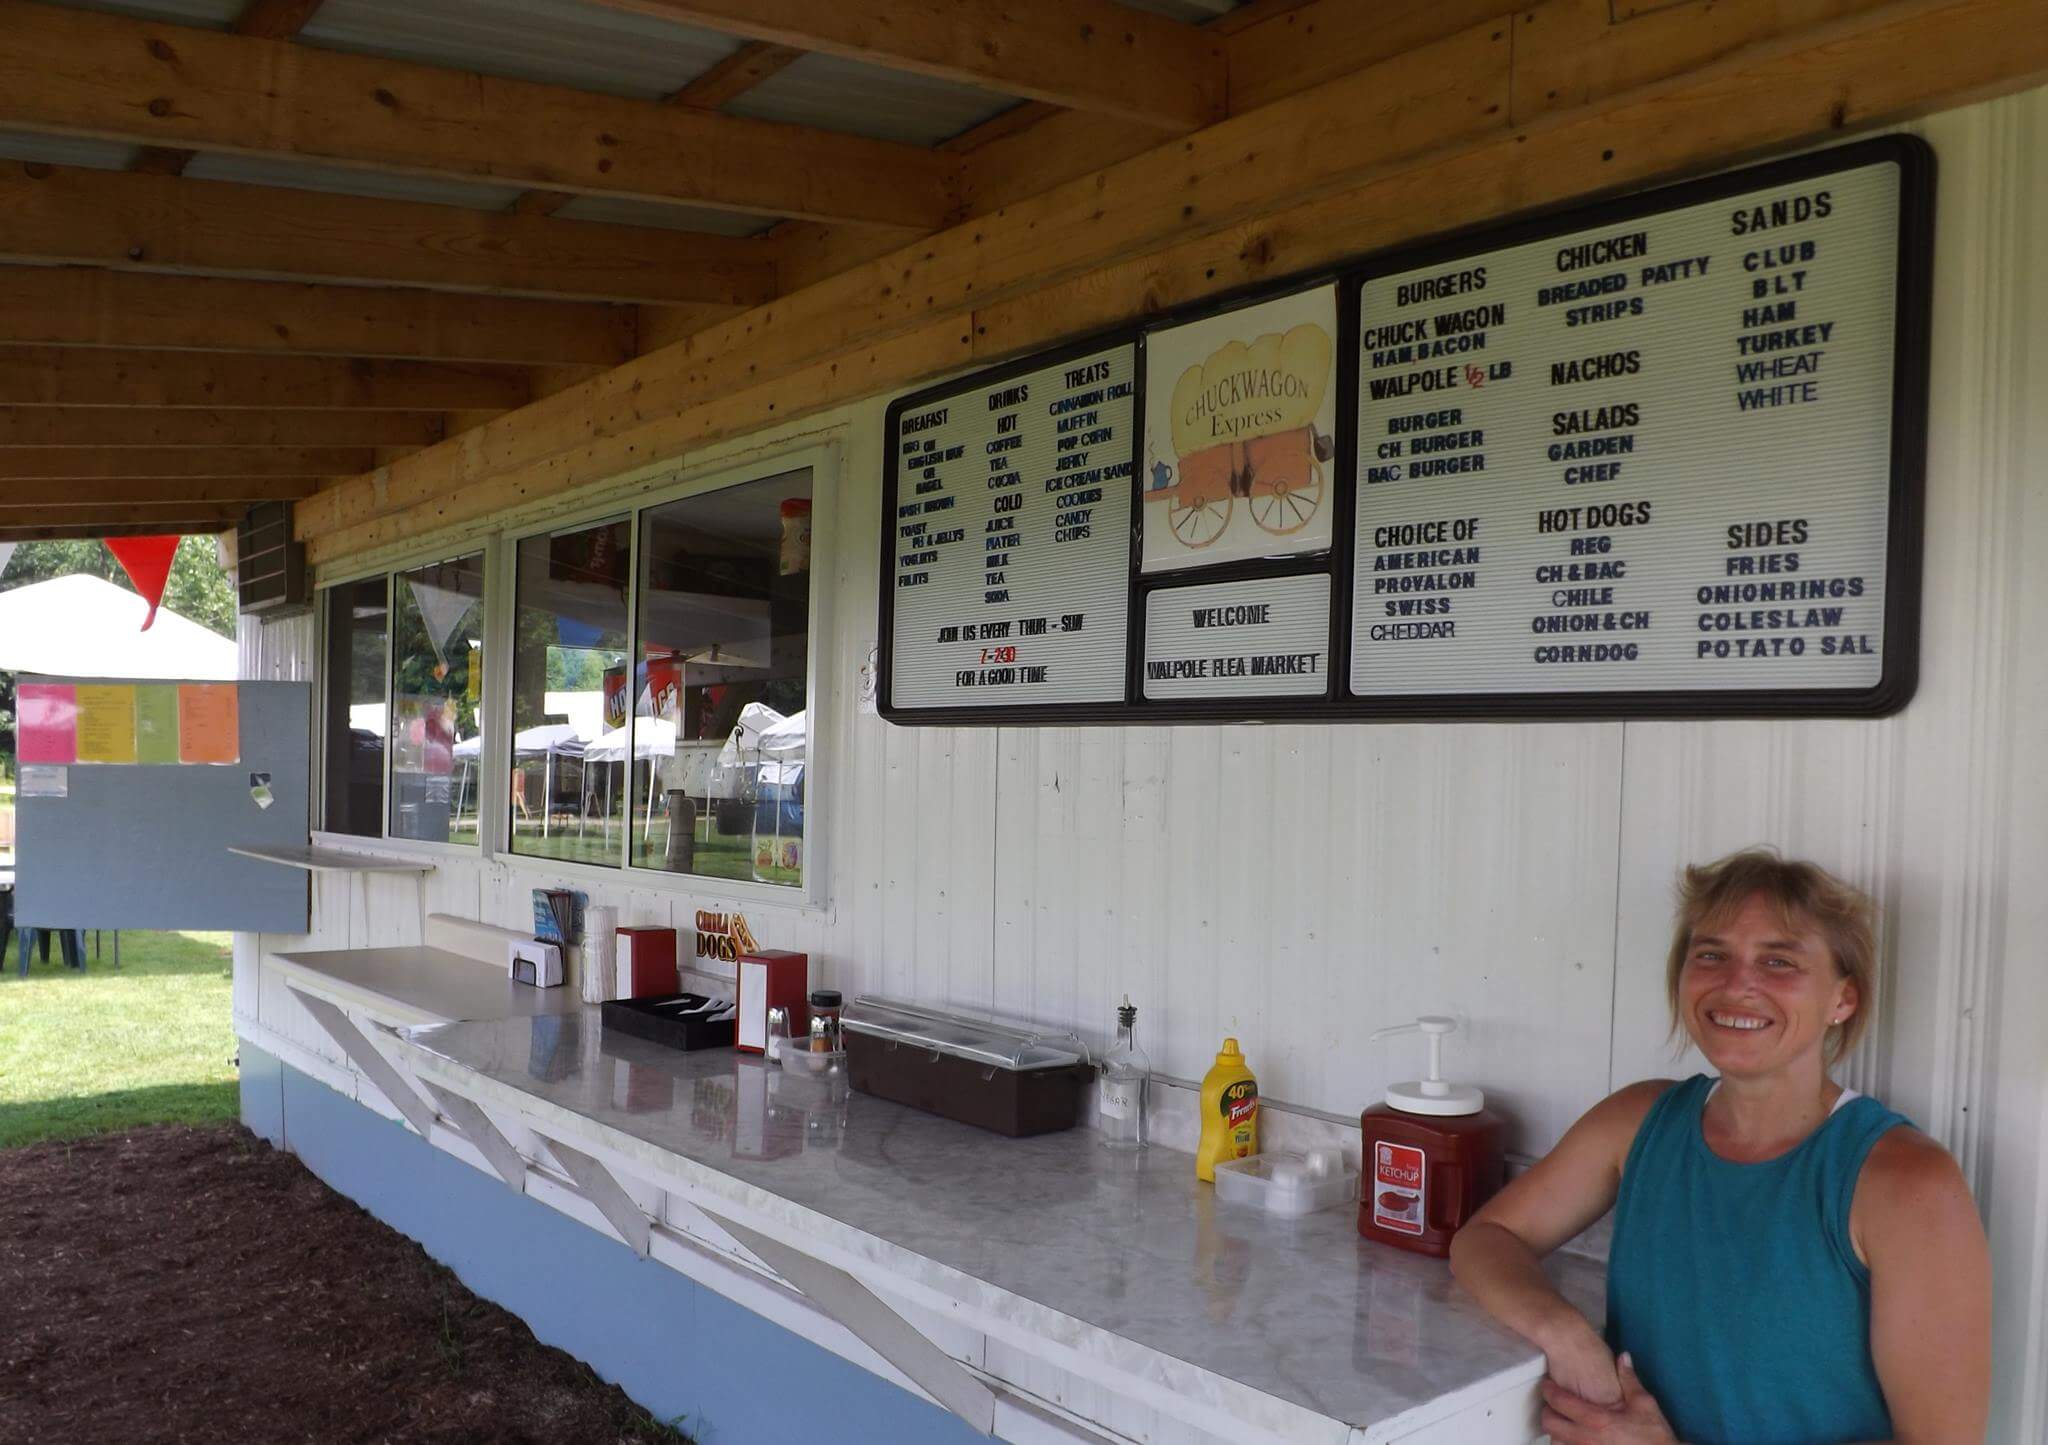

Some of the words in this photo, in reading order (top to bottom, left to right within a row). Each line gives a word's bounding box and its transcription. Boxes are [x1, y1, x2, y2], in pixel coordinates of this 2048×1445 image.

[1731, 191, 1832, 236] SANDS
[1557, 232, 1647, 272] CHICKEN
[1743, 240, 1816, 272] CLUB
[1397, 267, 1487, 307] BURGERS
[1537, 273, 1628, 306] BREADED
[1641, 255, 1711, 287] PATTY
[1565, 297, 1644, 327] STRIPS
[1743, 301, 1796, 328] HAM
[1364, 318, 1428, 350] CHUCK
[1434, 303, 1505, 337] WAGON
[1736, 321, 1835, 355] TURKEY
[1065, 361, 1109, 389] TREATS
[1551, 350, 1641, 386] NACHOS
[1736, 351, 1825, 384] WHEAT
[1369, 366, 1458, 400] WALPOLE
[1489, 361, 1512, 381] LB
[989, 384, 1028, 411] DRINKS
[1185, 369, 1309, 426] CHUCKWAGON
[1737, 381, 1818, 412] WHITE
[997, 414, 1018, 434] HOT
[1057, 411, 1097, 433] MUFFIN
[1210, 407, 1282, 437] Express
[1388, 408, 1462, 435] BURGER
[1552, 403, 1639, 436] SALADS
[986, 435, 1022, 454] COFFEE
[1057, 436, 1078, 452] POP
[1081, 427, 1112, 446] CORN
[1377, 441, 1402, 460] CH
[1410, 430, 1484, 455] BURGER
[1548, 435, 1634, 461] GARDEN
[990, 456, 1008, 472] TEA
[1056, 452, 1090, 472] JERKY
[1367, 464, 1401, 484] BAC
[1409, 454, 1485, 478] BURGER
[1564, 462, 1622, 485] CHEF
[988, 471, 1022, 489] COCOA
[1045, 477, 1063, 493] ICE
[1064, 468, 1102, 488] CREAM
[994, 493, 1022, 513] COLD
[1056, 488, 1102, 509] COOKIES
[985, 516, 1014, 533] JUICE
[1055, 509, 1093, 527] CANDY
[1538, 508, 1582, 533] HOT
[1587, 501, 1651, 529] DOGS
[900, 522, 927, 538] TOAST
[1055, 525, 1090, 542] CHIPS
[1374, 520, 1448, 548] CHOICE
[1453, 517, 1479, 541] OF
[1727, 519, 1808, 549] SIDES
[1570, 535, 1612, 556] REG
[986, 553, 1009, 568] MILK
[1373, 547, 1480, 572] AMERICAN
[1726, 552, 1800, 577] FRIES
[985, 572, 1005, 586] TEA
[1374, 571, 1476, 594] PROVALON
[1536, 565, 1563, 583] CH
[985, 589, 1010, 604] SODA
[1384, 597, 1451, 617] SWISS
[1552, 587, 1614, 608] CHILE
[1193, 604, 1270, 628] WELCOME
[1532, 613, 1599, 634] ONION
[1698, 607, 1844, 632] COLESLAW
[937, 626, 959, 643] JOIN
[962, 624, 976, 641] US
[980, 621, 1011, 639] EVERY
[1018, 617, 1047, 636] THUR
[1370, 621, 1456, 641] CHEDDAR
[1697, 637, 1806, 659] POTATO
[1820, 635, 1876, 656] SAL
[955, 670, 976, 687] FOR
[978, 670, 986, 686] A
[988, 668, 1015, 685] GOOD
[1019, 666, 1048, 683] TIME
[1148, 659, 1208, 680] WALPOLE
[1212, 657, 1246, 678] FLEA
[1251, 653, 1320, 676] MARKET
[696, 932, 737, 962] DOGS
[1379, 1165, 1420, 1182] KETCHUP
